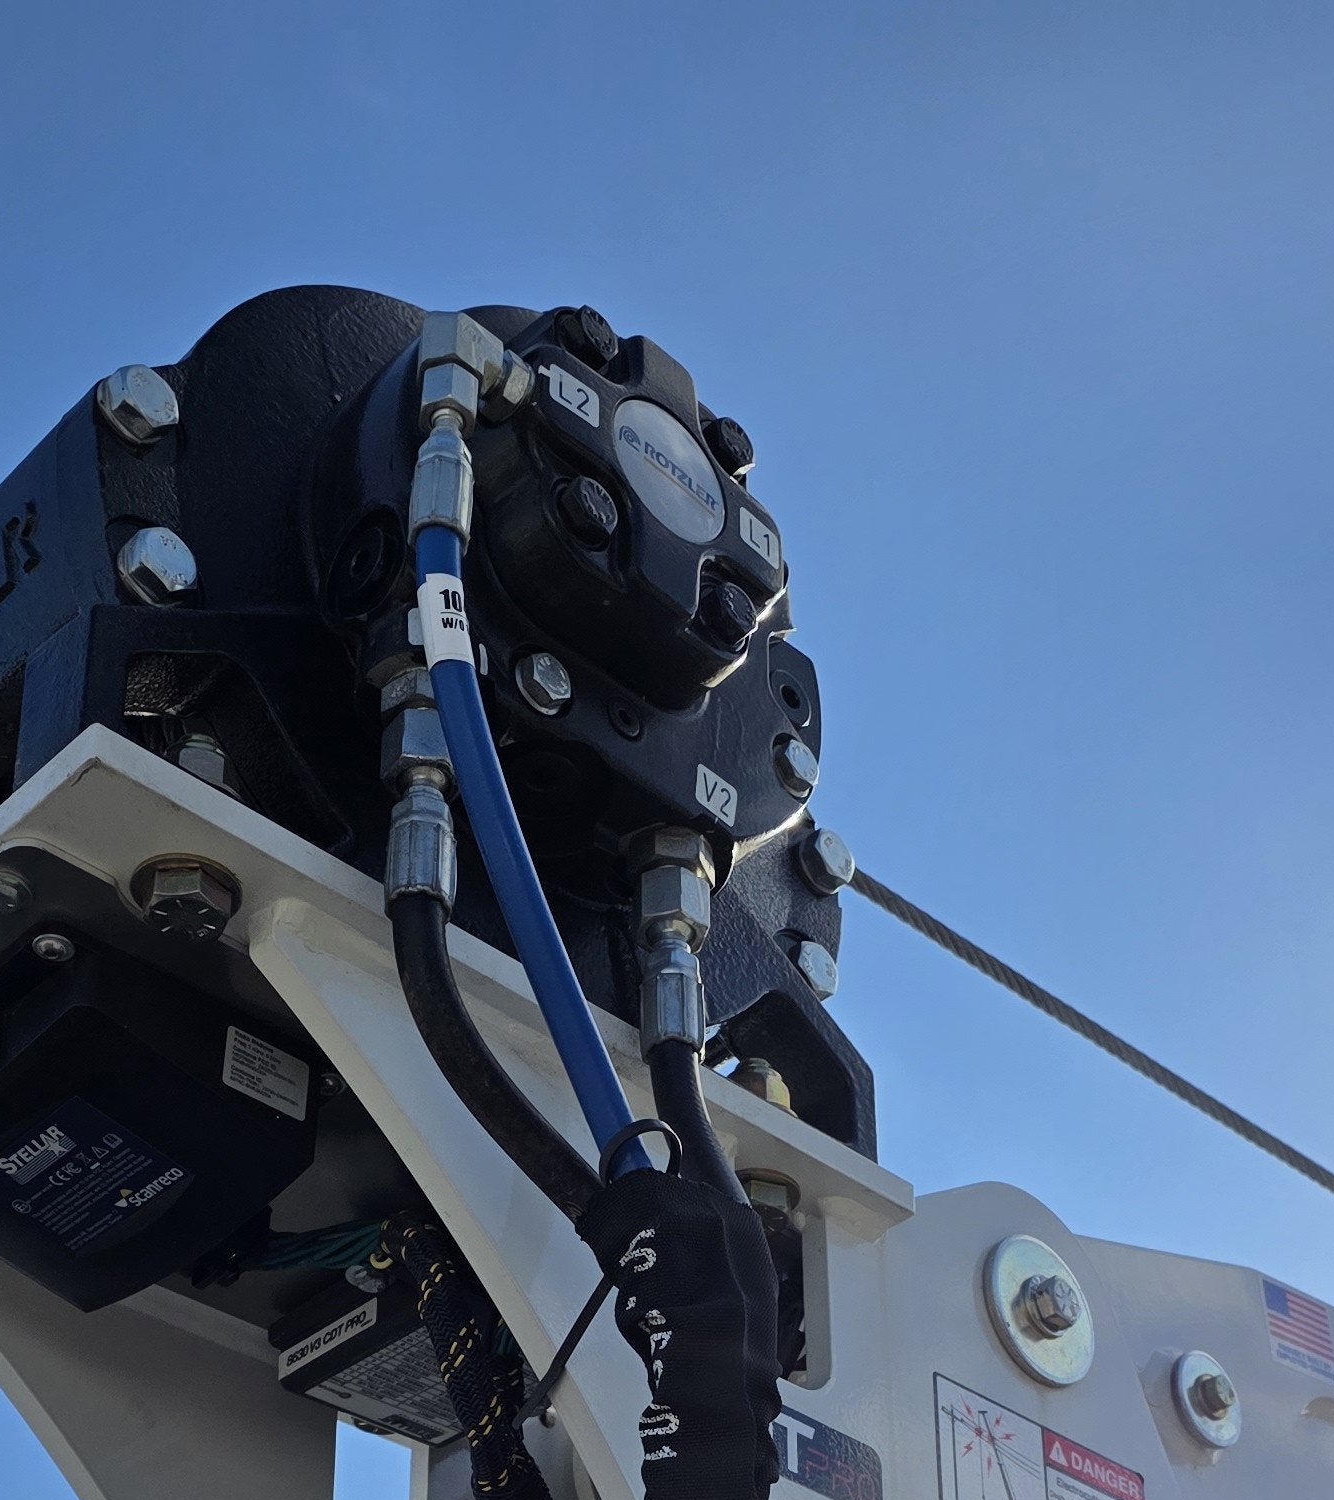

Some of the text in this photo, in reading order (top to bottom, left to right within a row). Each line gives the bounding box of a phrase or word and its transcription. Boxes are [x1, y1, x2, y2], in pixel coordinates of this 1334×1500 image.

[559, 373, 590, 417] L2
[644, 442, 718, 511] ROTZLER
[749, 518, 770, 557] L1
[702, 772, 731, 818] V2
[129, 1167, 184, 1207] scanreco
[287, 1346, 310, 1367] 8630
[322, 1326, 344, 1345] CDT
[344, 1310, 367, 1334] PRO
[1071, 1452, 1139, 1499] DANGER
